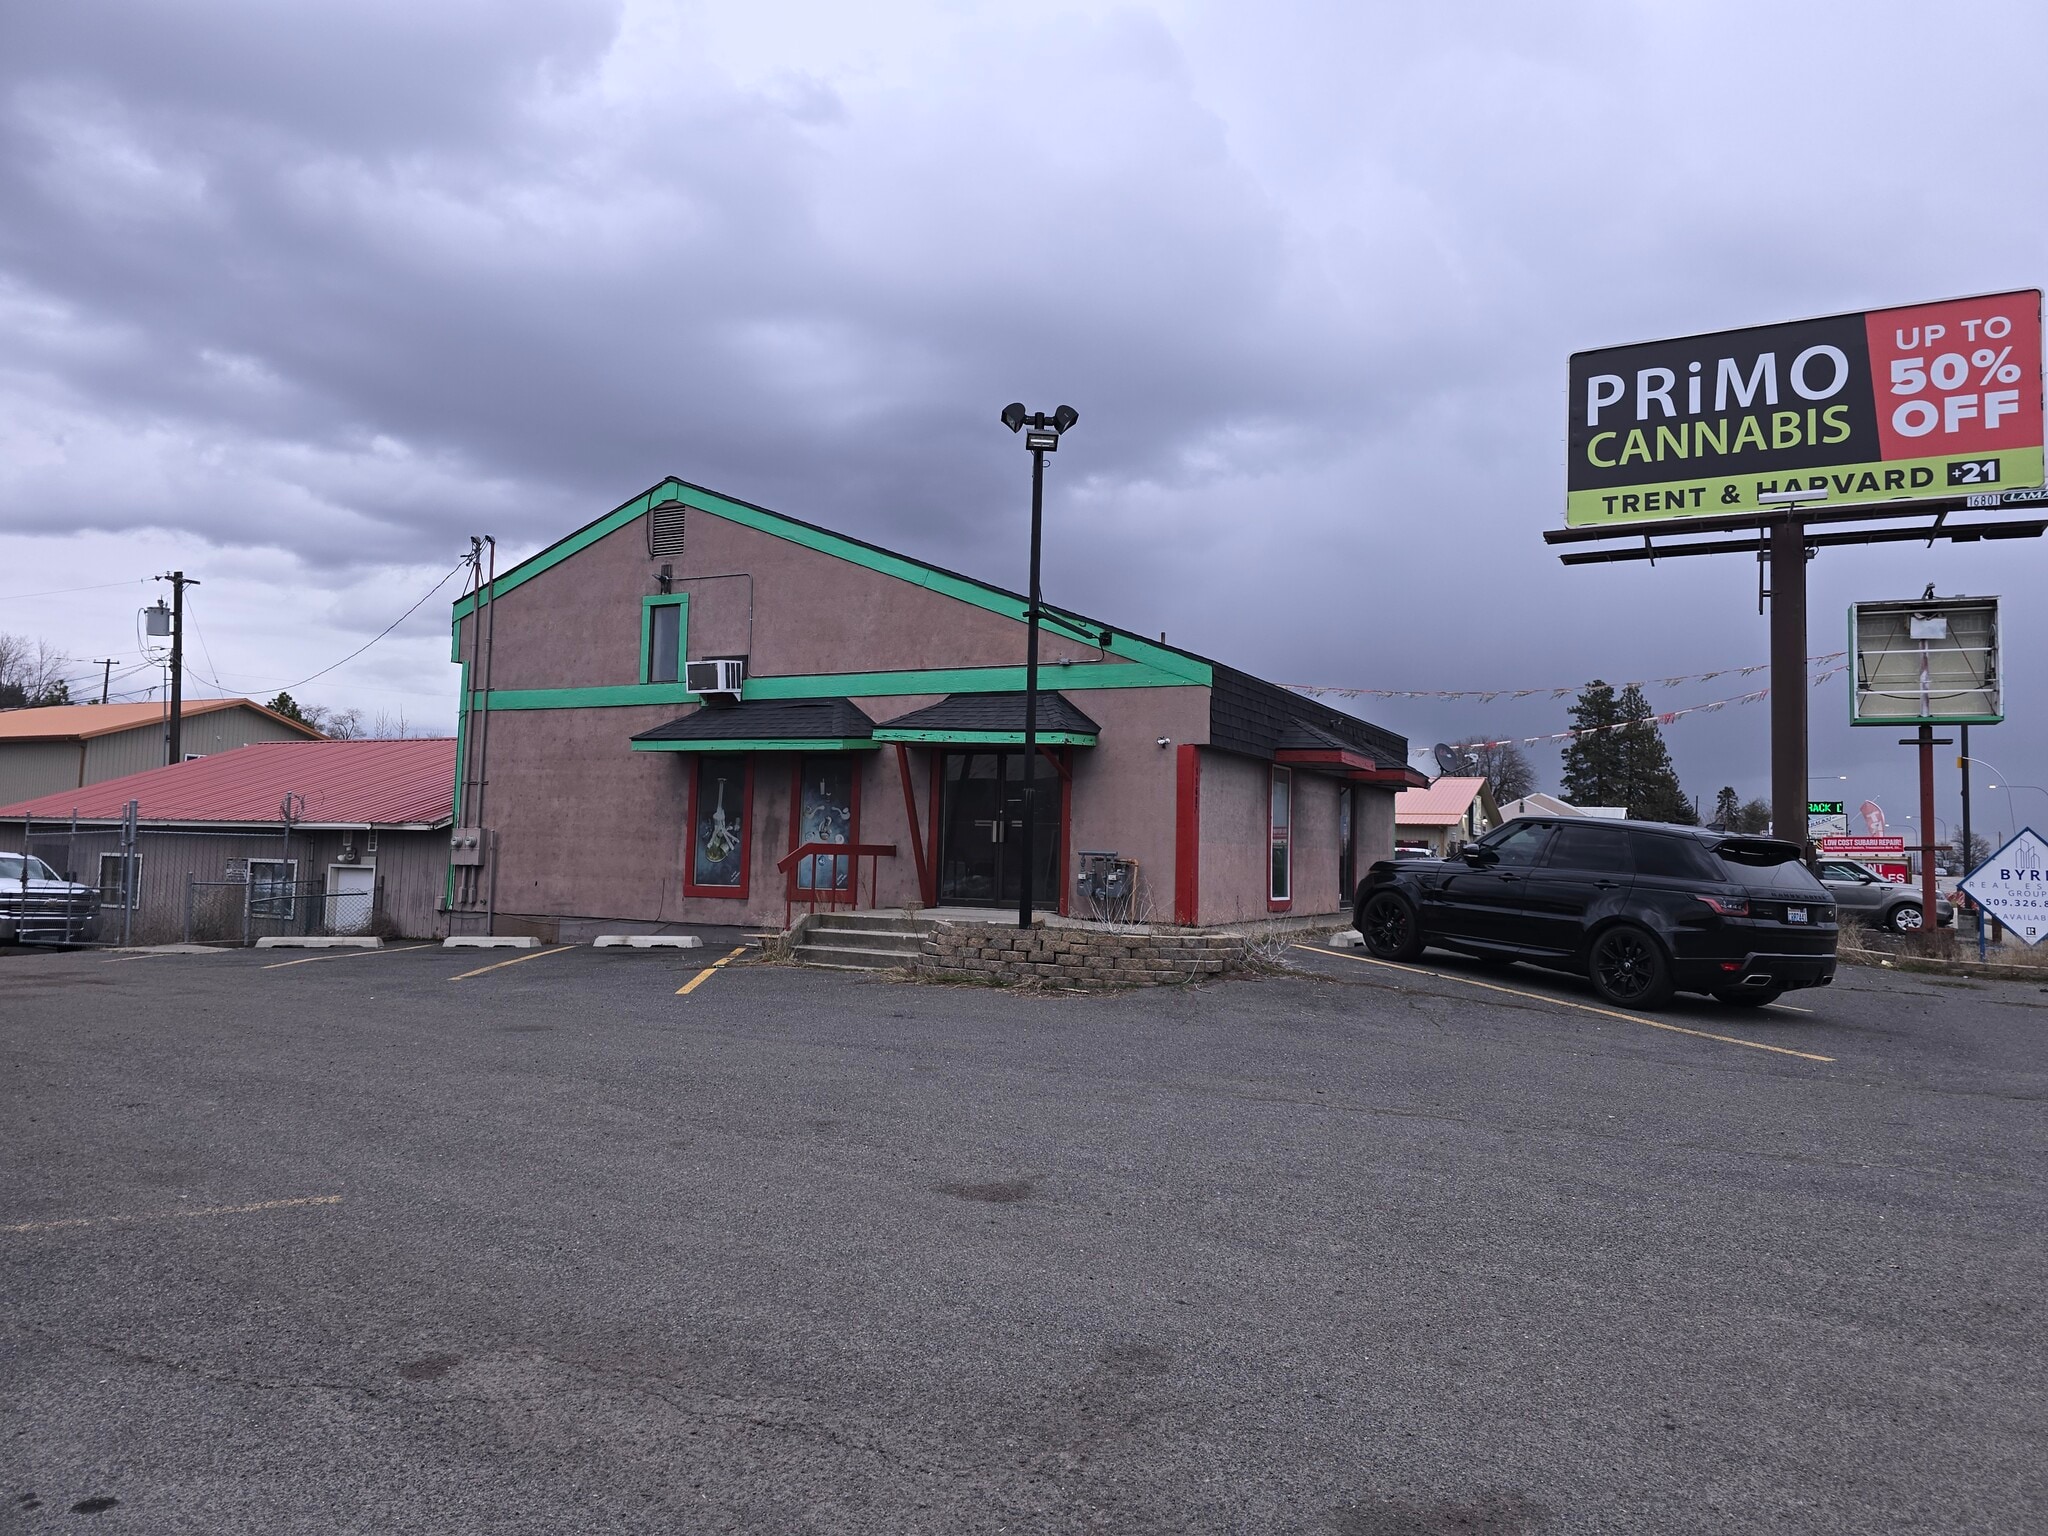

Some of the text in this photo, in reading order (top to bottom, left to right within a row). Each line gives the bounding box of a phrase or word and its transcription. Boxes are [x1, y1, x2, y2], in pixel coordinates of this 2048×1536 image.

[1896, 316, 2012, 350] UP TO
[1587, 344, 1849, 427] PRiMO
[1890, 345, 2021, 396] 50%
[1587, 404, 1851, 468] CANNABIS
[1892, 389, 2019, 438] OFF
[1602, 487, 1706, 515] TRENT
[1720, 484, 1741, 505] &
[1952, 461, 1996, 483] +21
[1969, 494, 1999, 507] 16801
[1969, 881, 2010, 889] REAL
[2008, 890, 2047, 898] GROUP
